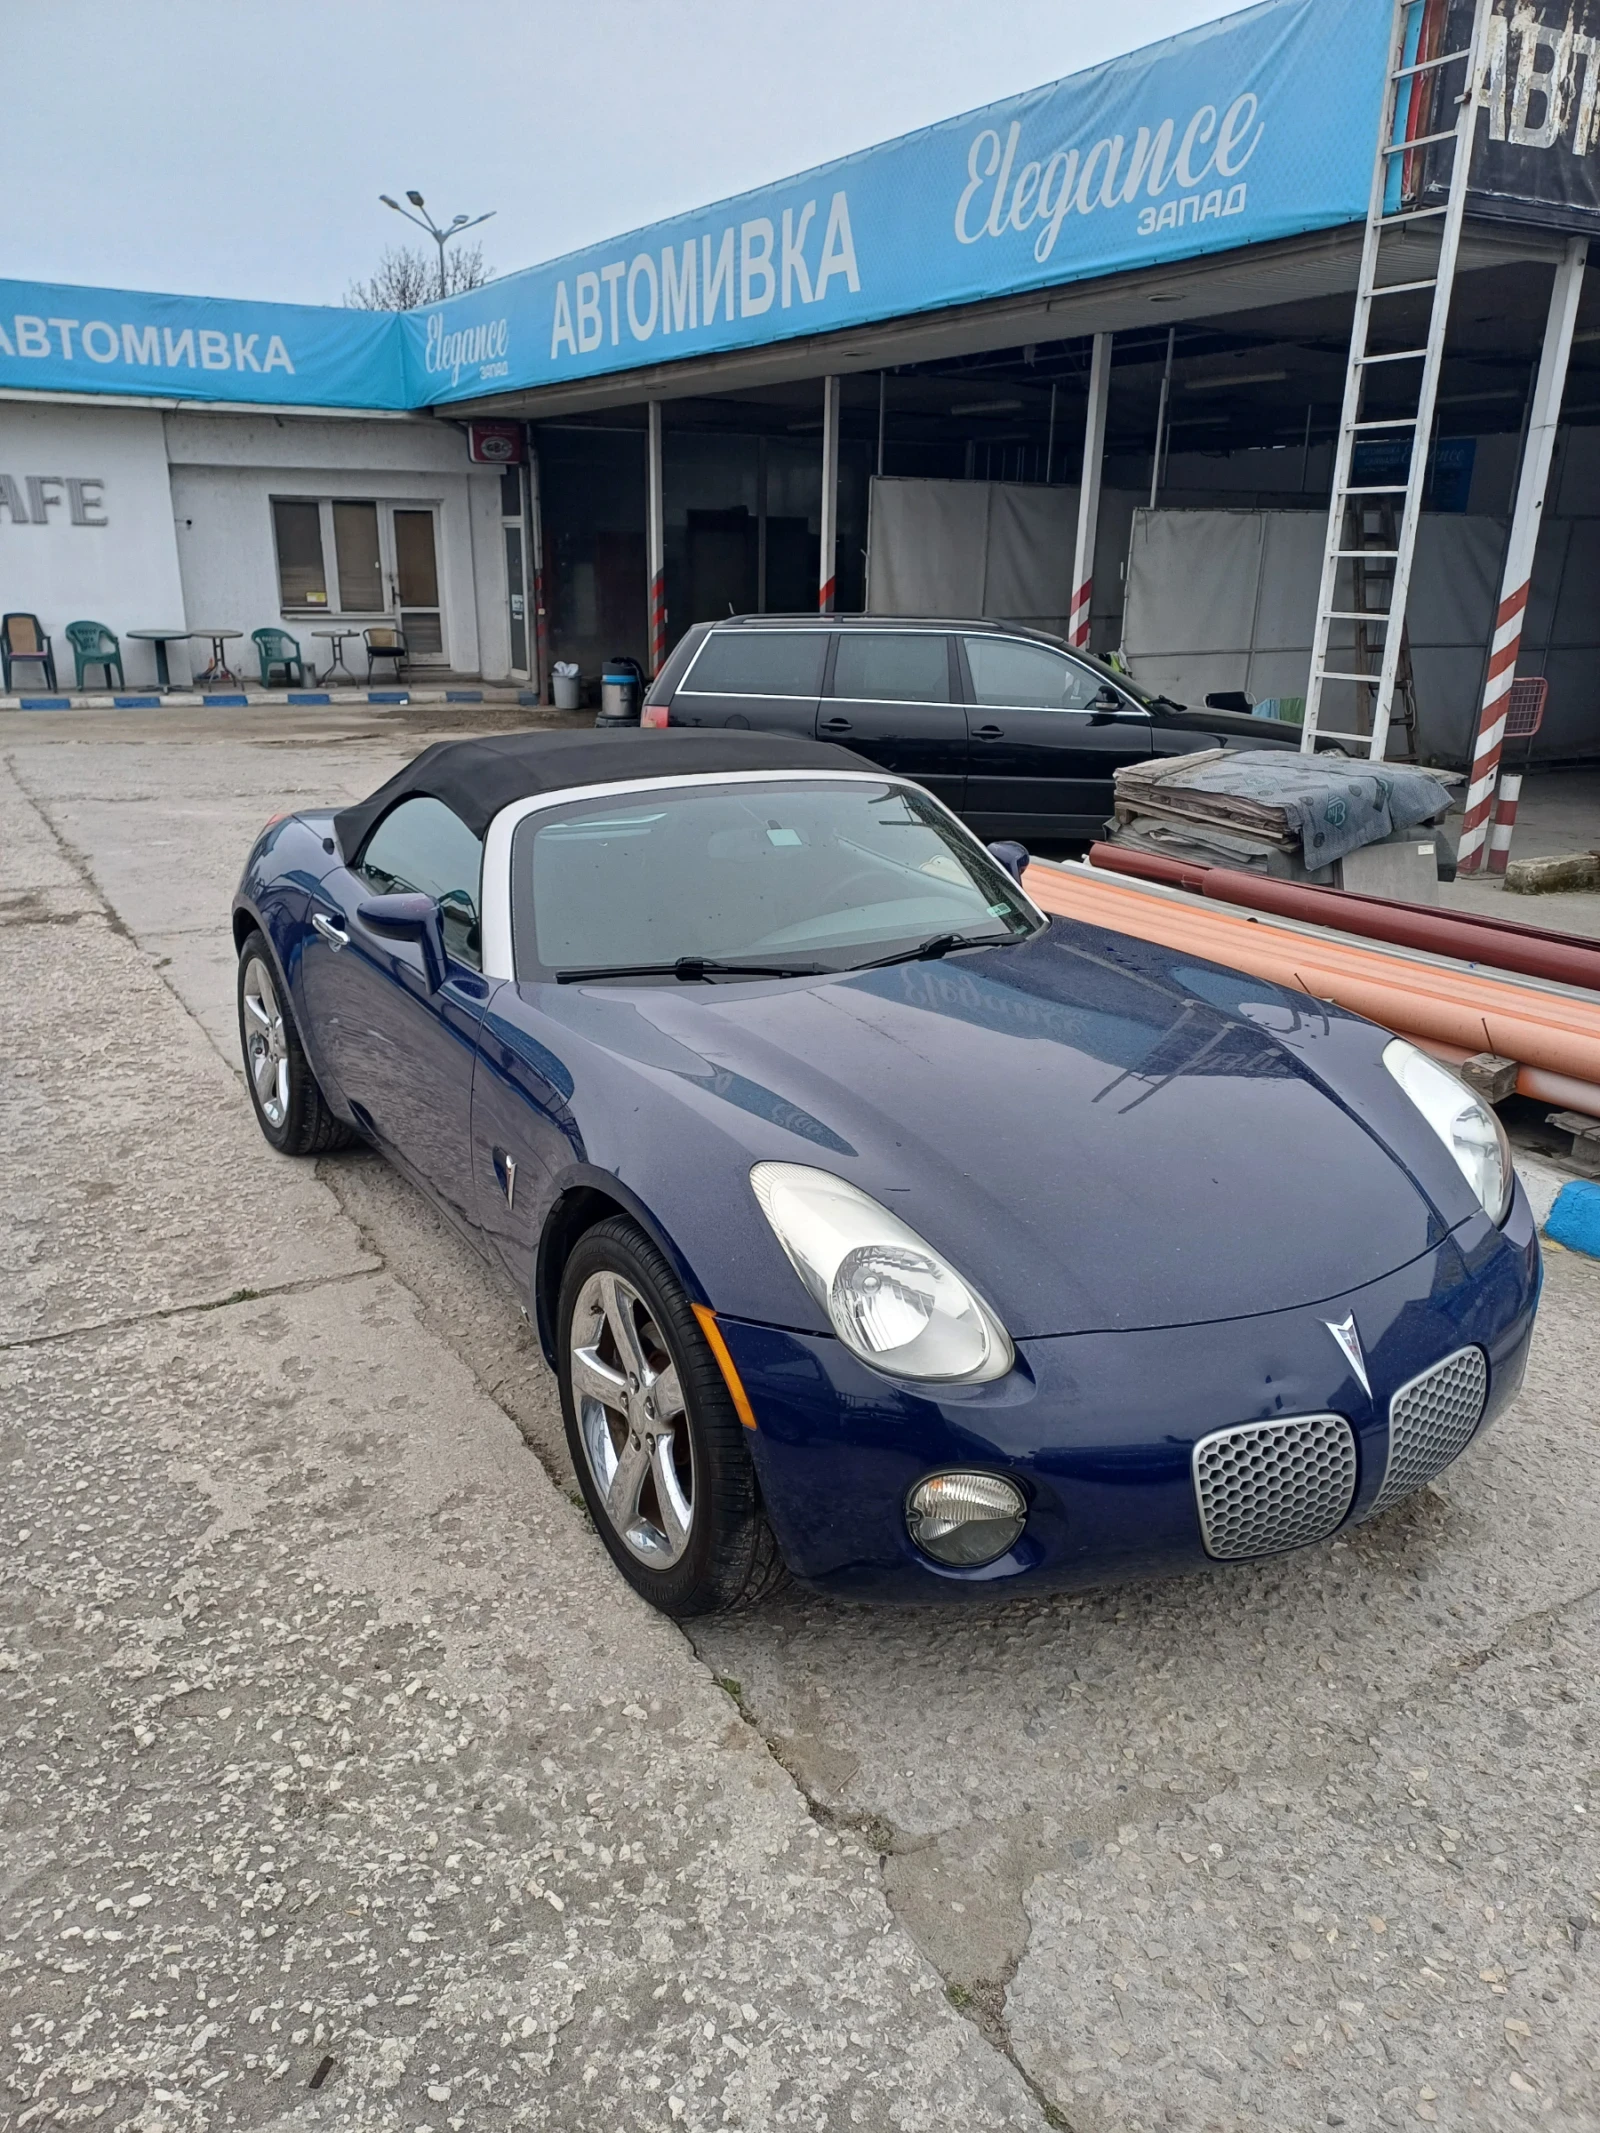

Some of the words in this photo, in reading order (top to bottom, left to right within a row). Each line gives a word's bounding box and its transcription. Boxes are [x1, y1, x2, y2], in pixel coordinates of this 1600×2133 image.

[954, 92, 1266, 264] Elegance
[1136, 182, 1248, 236] ЗАПАД
[550, 190, 862, 361] АВТОМИВКА
[425, 311, 509, 388] Elegance
[479, 361, 508, 380] ЗАПАД
